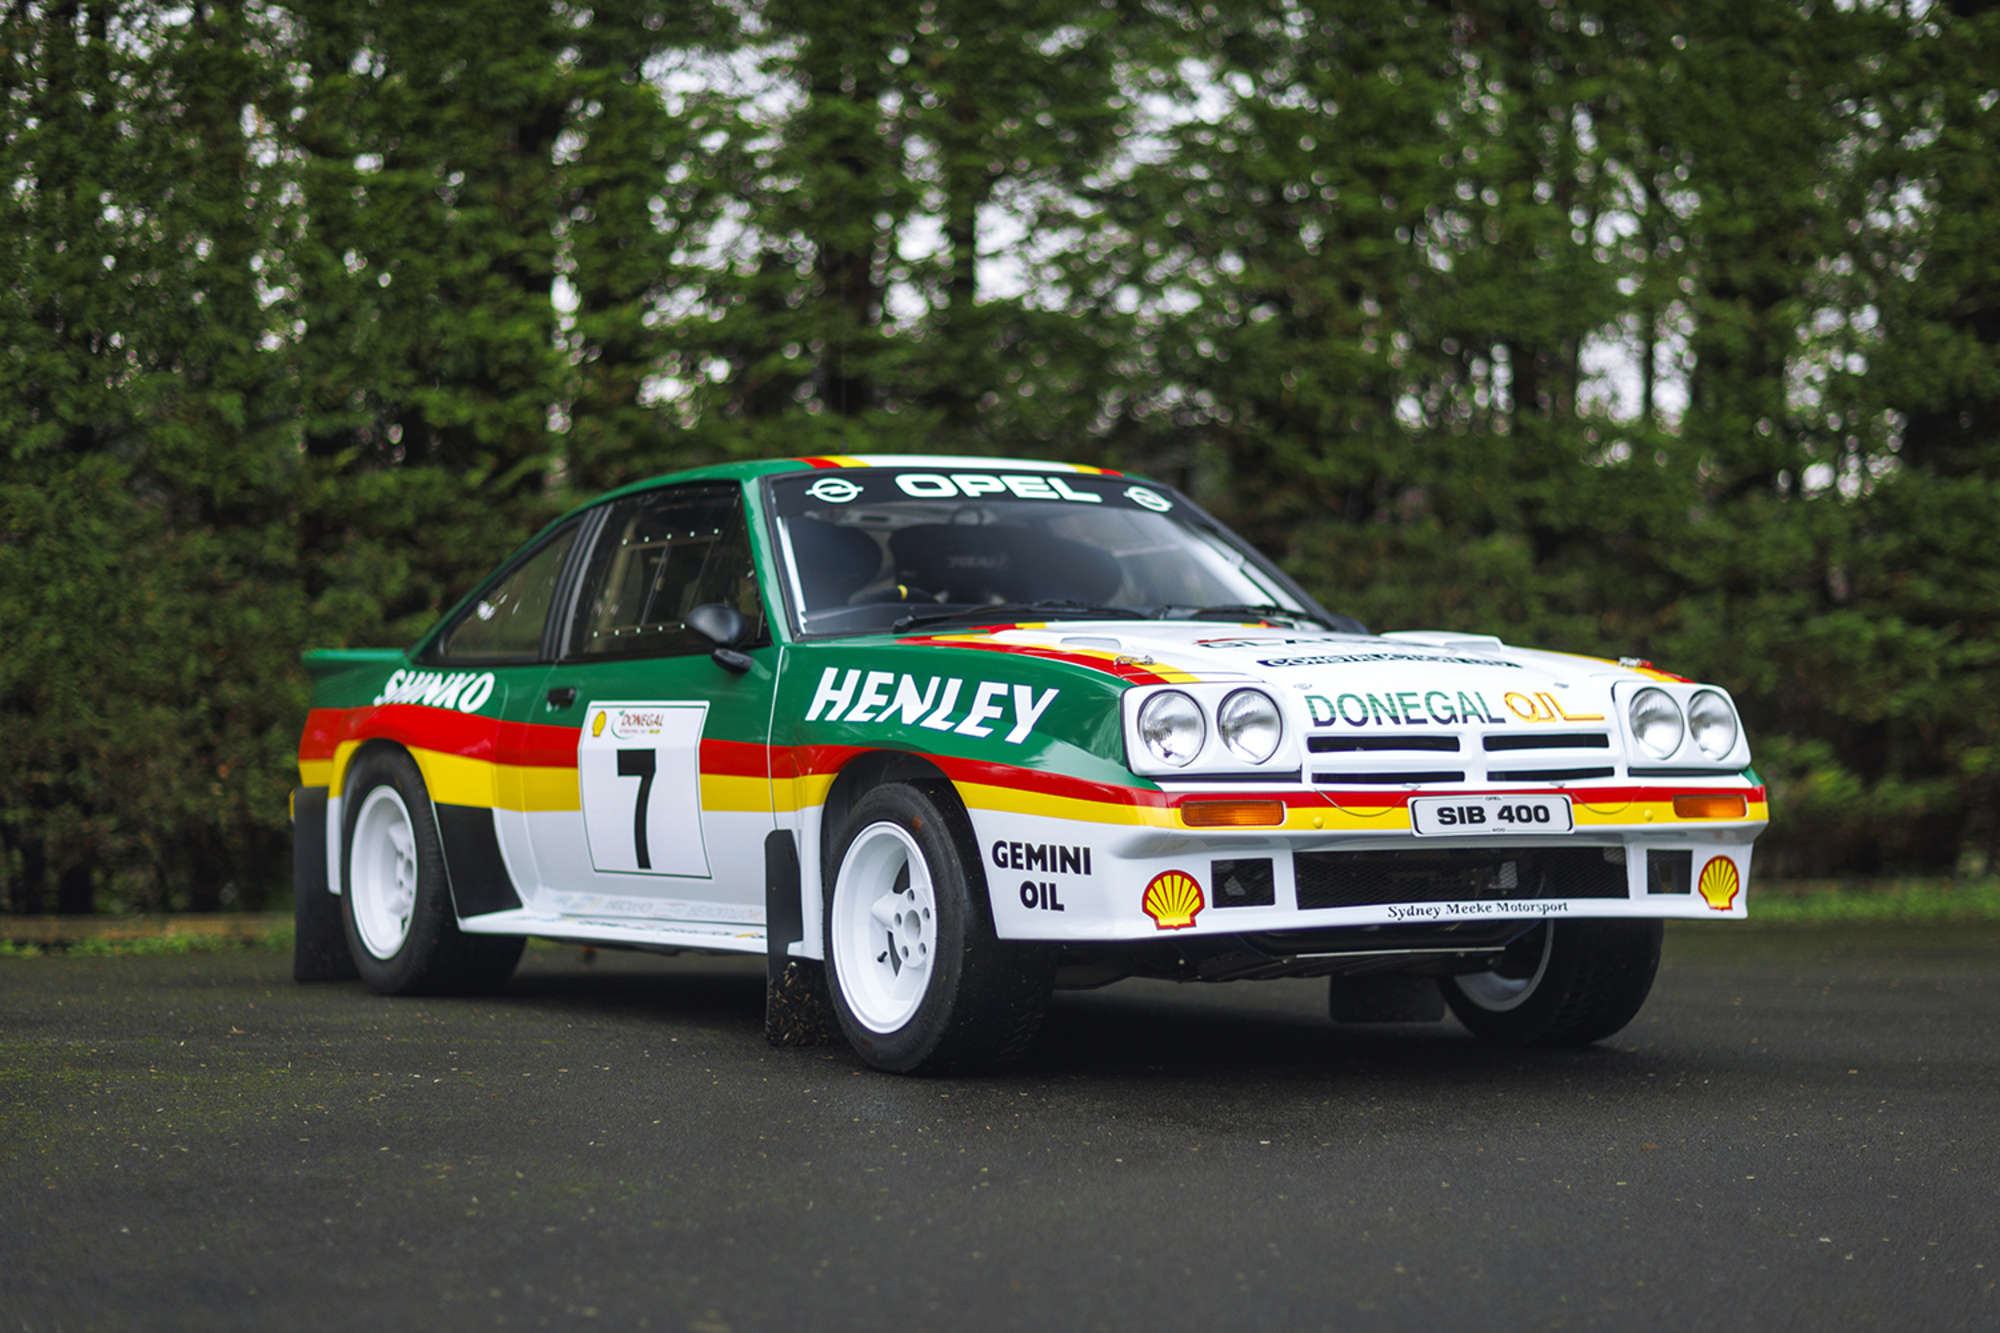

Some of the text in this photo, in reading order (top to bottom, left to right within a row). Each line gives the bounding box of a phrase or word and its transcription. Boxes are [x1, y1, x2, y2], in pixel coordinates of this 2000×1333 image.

[895, 474, 1102, 503] OPEL
[373, 668, 495, 713] SHINKO
[804, 667, 1060, 744] HENLEY
[621, 713, 664, 727] DONEGAL
[1304, 691, 1605, 727] DONEGAL OIL
[617, 748, 656, 869] 7
[1437, 805, 1550, 826] SIB 400
[991, 840, 1092, 876] GEMINI
[1020, 880, 1065, 912] OIL
[1387, 902, 1569, 921] Sydney Meeke Motorsport
